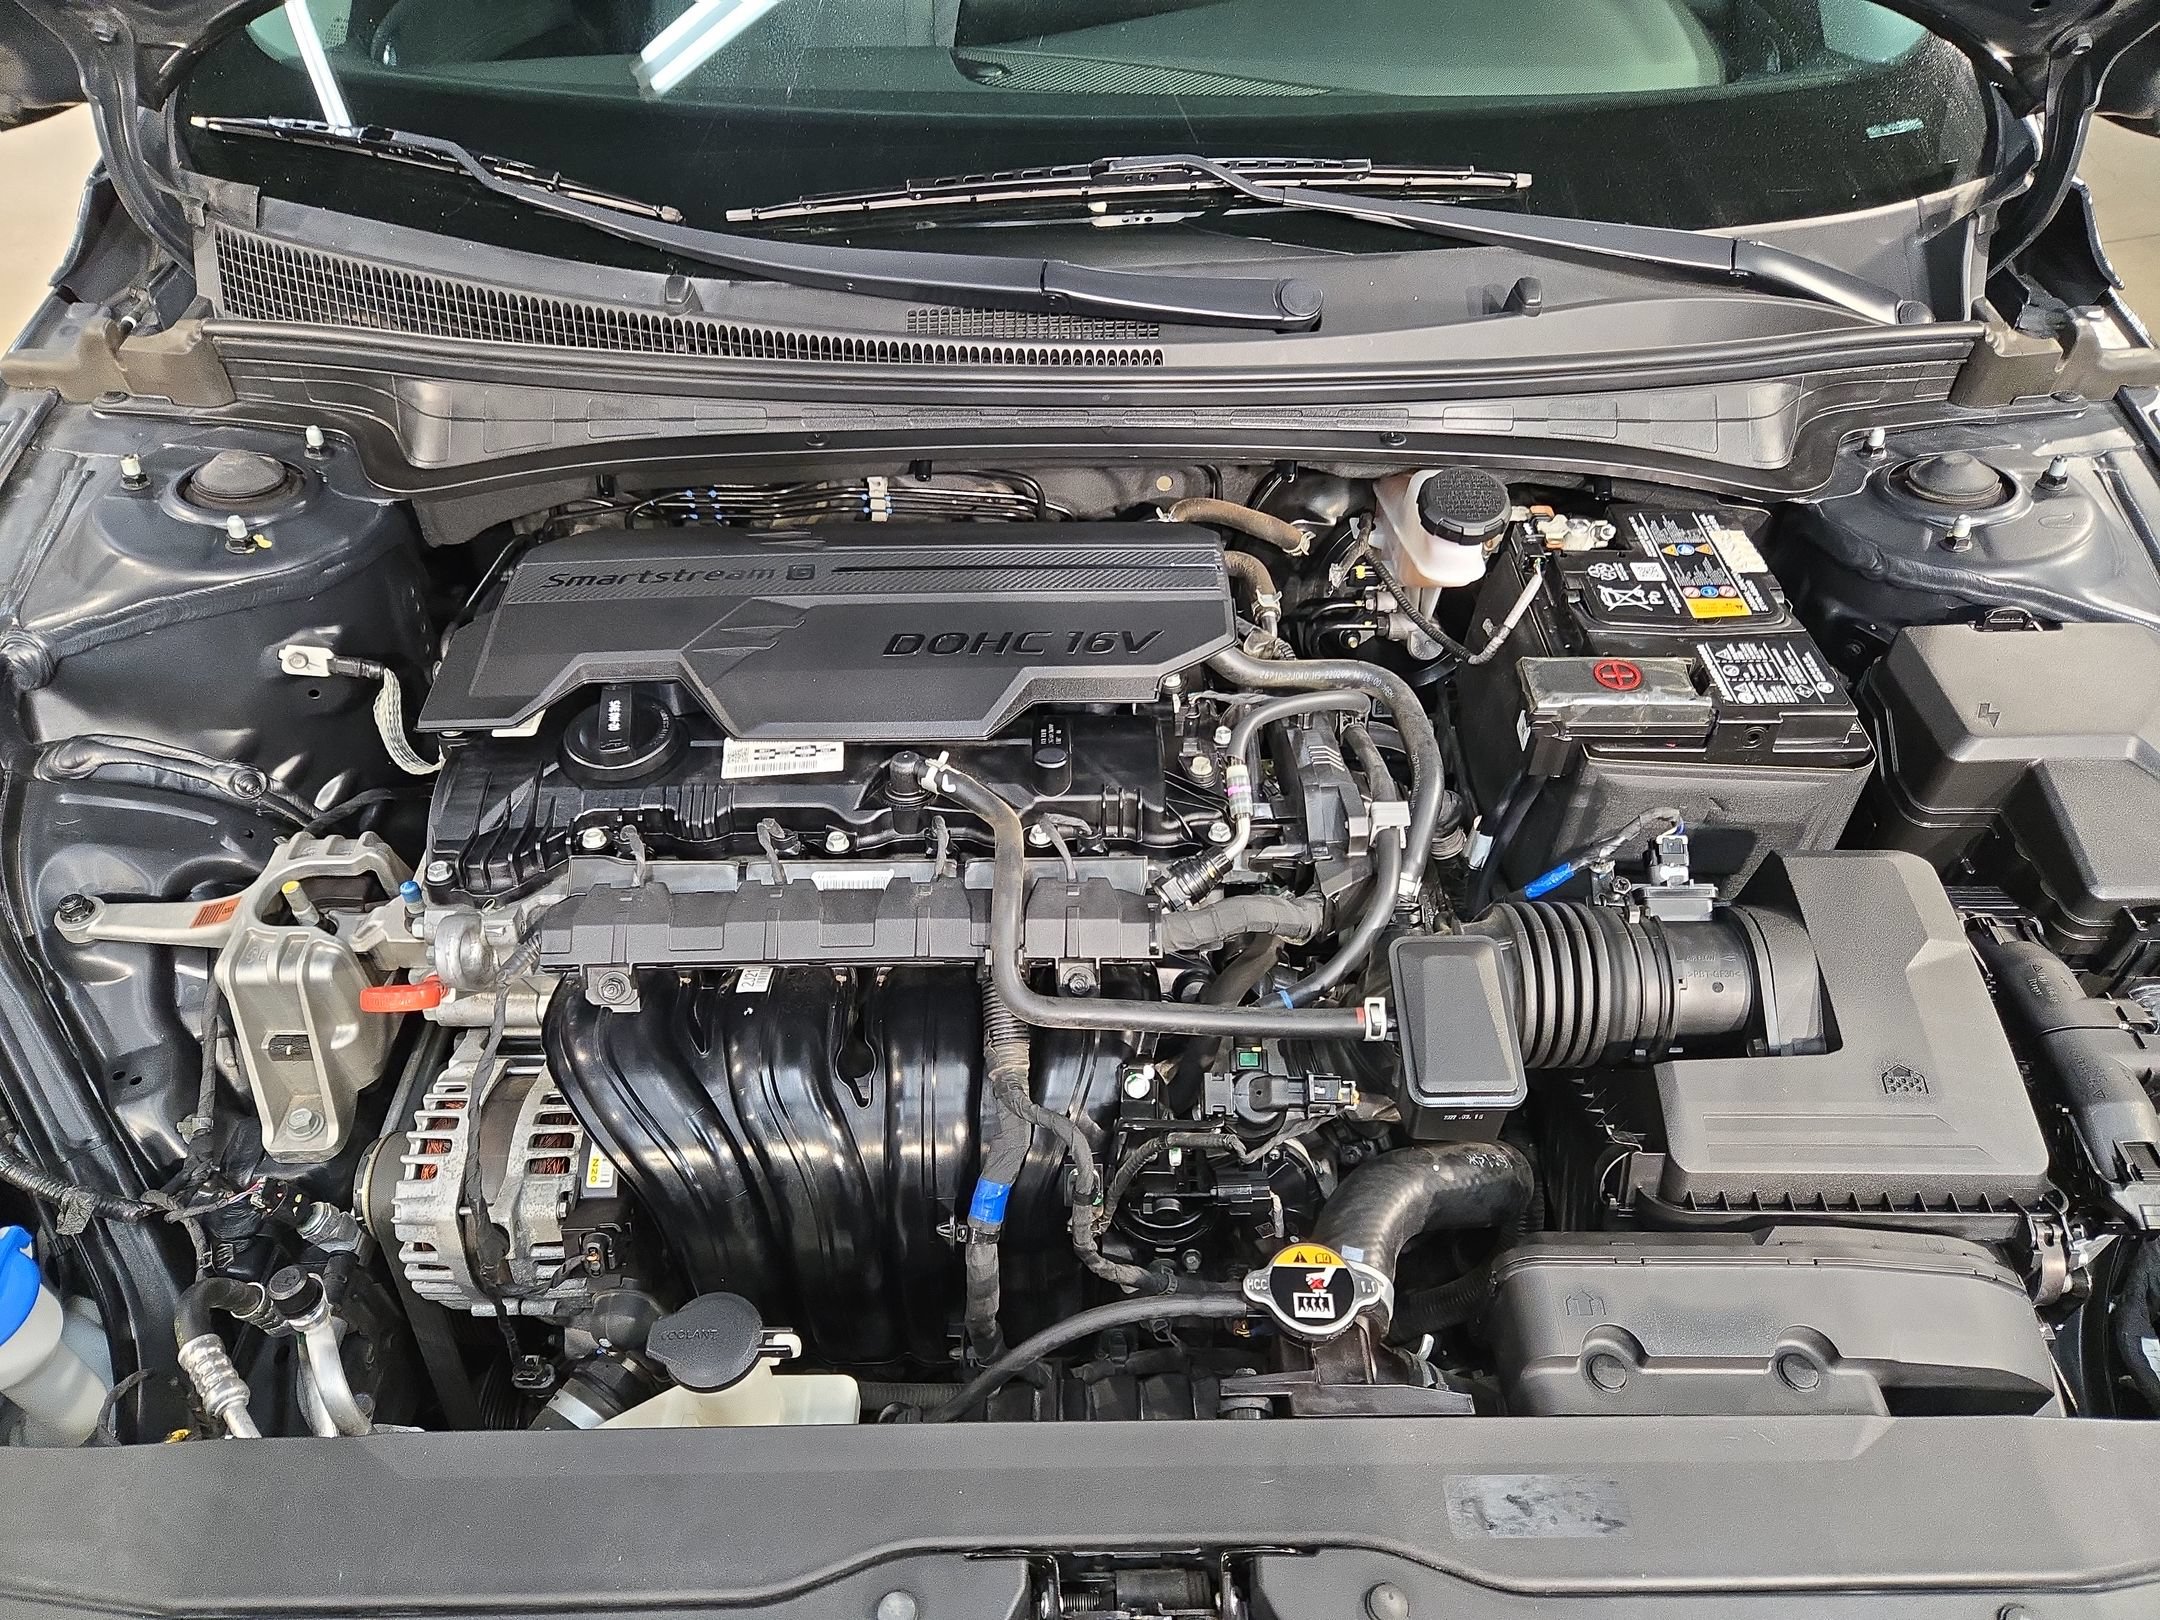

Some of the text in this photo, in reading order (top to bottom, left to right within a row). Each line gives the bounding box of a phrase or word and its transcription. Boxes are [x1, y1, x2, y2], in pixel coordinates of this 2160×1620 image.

[541, 567, 775, 589] Smartstream
[882, 629, 1165, 657] DOHC 16V
[1246, 1277, 1269, 1291] HCC
[660, 1327, 719, 1341] COOLANT
